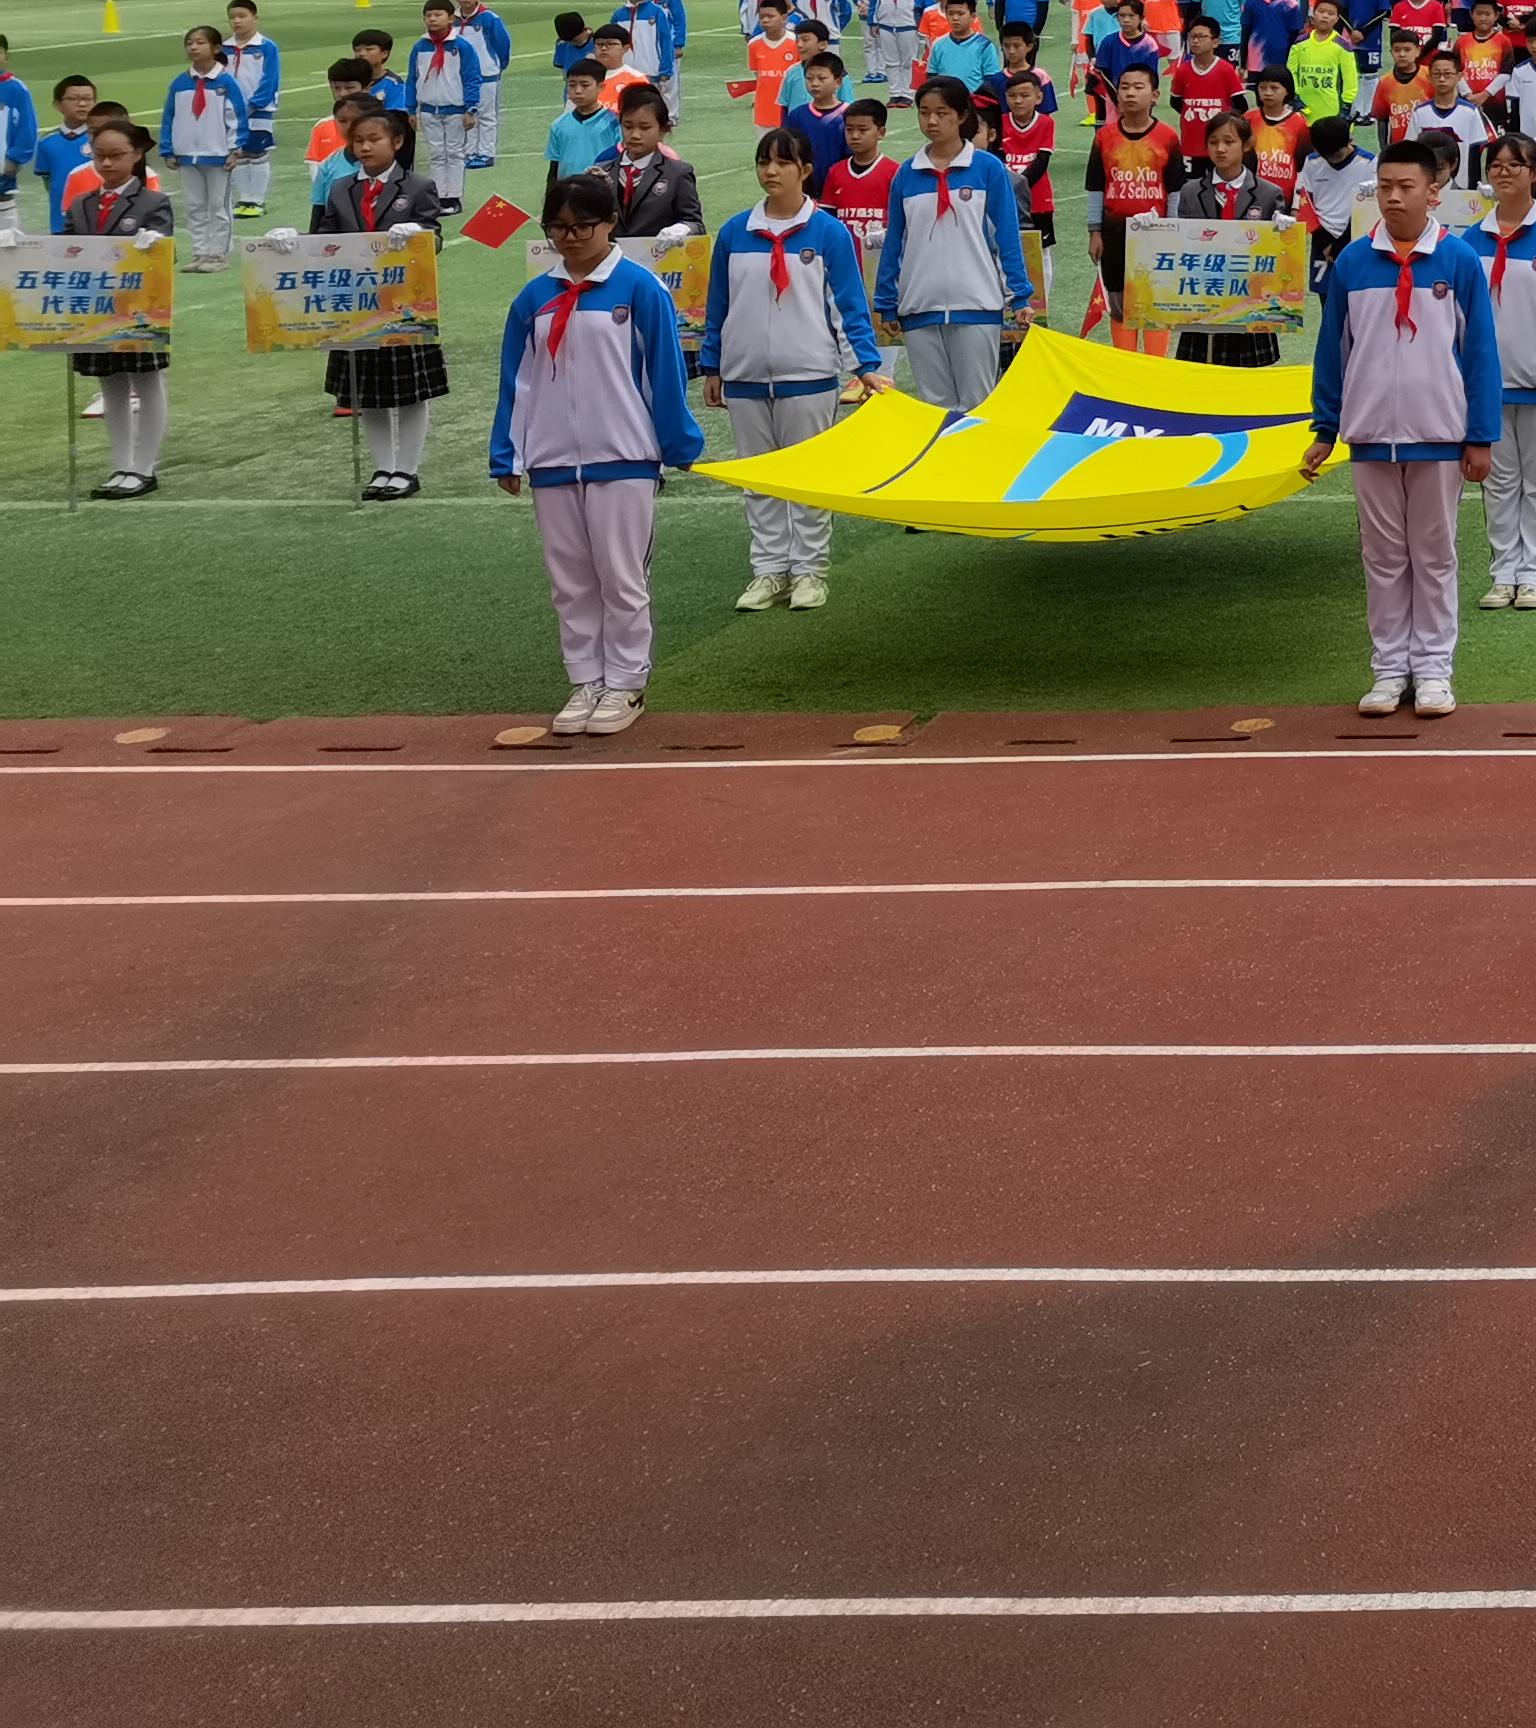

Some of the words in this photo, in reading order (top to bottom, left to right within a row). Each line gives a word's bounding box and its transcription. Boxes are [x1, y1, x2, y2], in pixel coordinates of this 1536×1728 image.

[1368, 52, 1380, 64] 15
[1390, 103, 1408, 115] Gao
[1271, 148, 1291, 164] Xin
[1136, 167, 1157, 181] Xin
[1260, 161, 1292, 179] School
[1120, 184, 1126, 199] 2
[1128, 184, 1163, 199] School
[1153, 252, 1277, 273] 五年级三班
[1313, 260, 1328, 282] 7
[16, 270, 145, 290] 五年级七班
[274, 266, 406, 290] 五年级六班
[1178, 276, 1249, 297] 代表队
[41, 295, 117, 315] 代表队
[304, 292, 380, 314] 代表队
